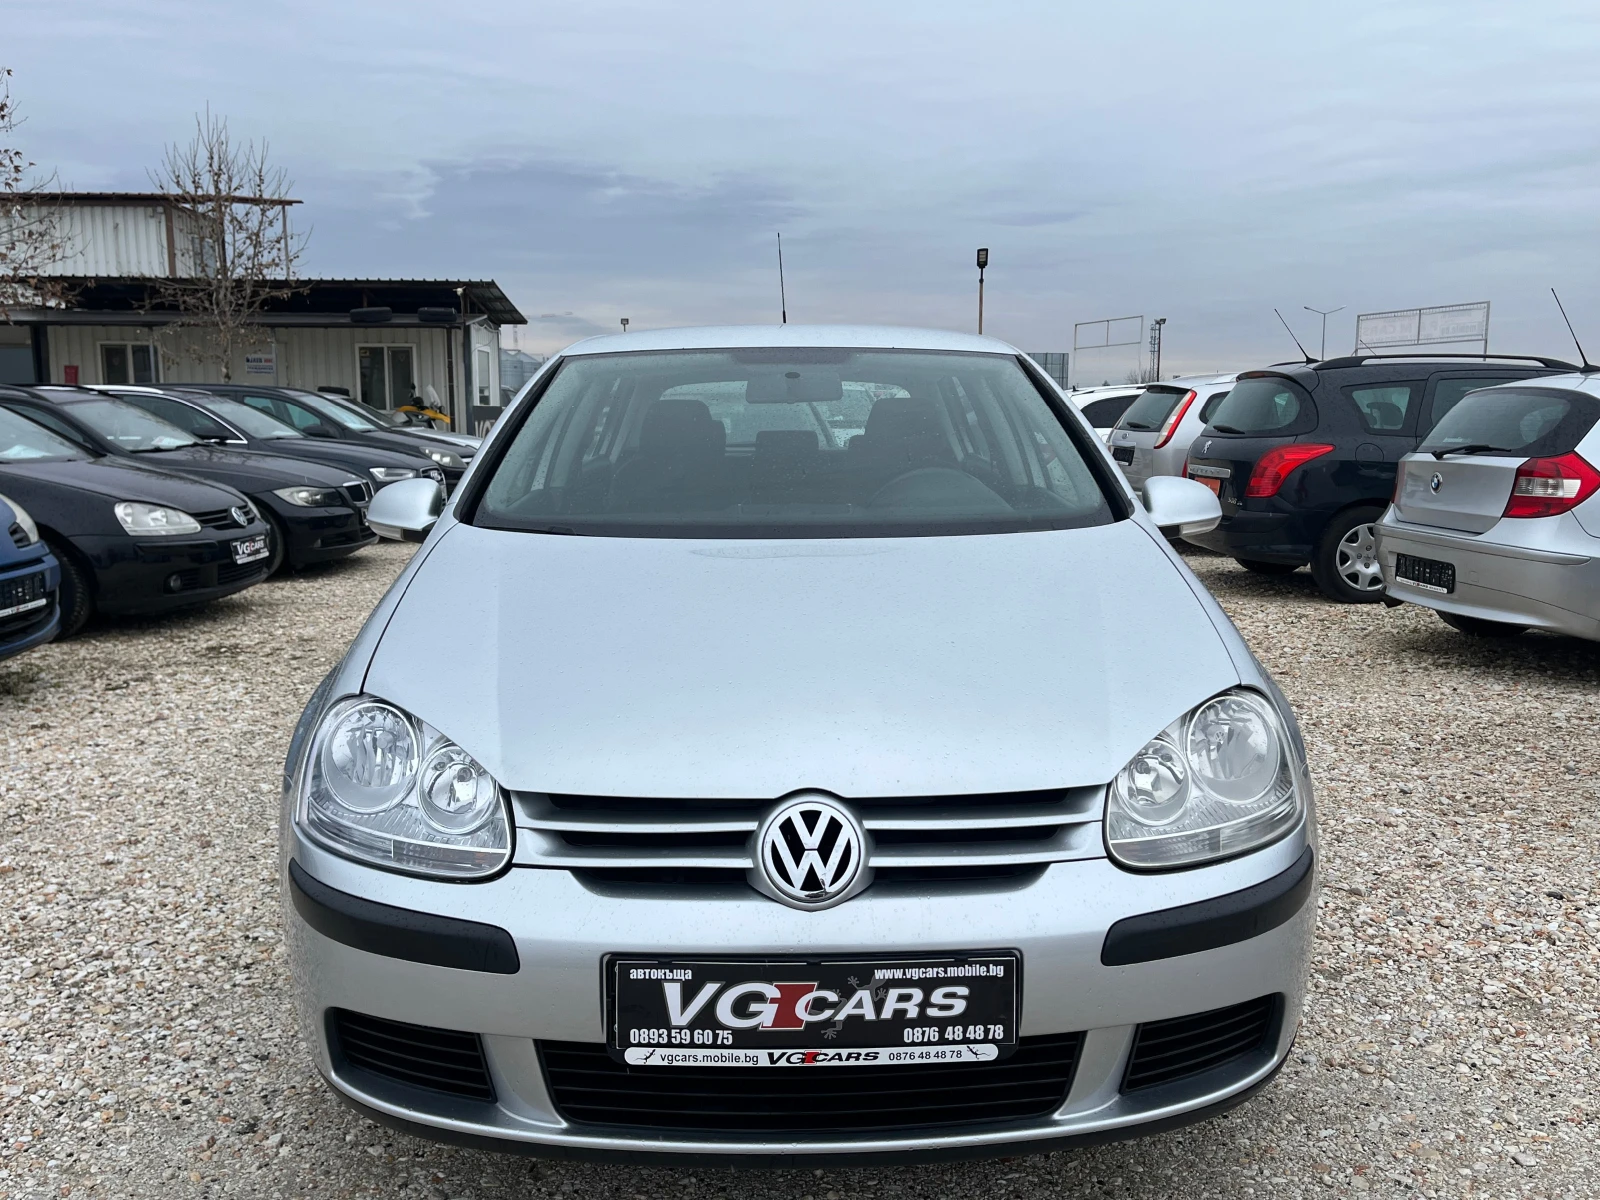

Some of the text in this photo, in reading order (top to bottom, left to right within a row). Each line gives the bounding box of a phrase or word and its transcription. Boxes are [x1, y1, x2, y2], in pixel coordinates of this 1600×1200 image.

[629, 968, 693, 981] автокъща
[874, 963, 1005, 980] www.vgcars.mobile.bg
[629, 1028, 733, 1045] 0893 59 60 75
[903, 1023, 1004, 1043] 0876 48 48 78
[659, 1052, 759, 1066] vgcars.mobile.bg
[888, 1049, 963, 1061] 0876 48 48 78
